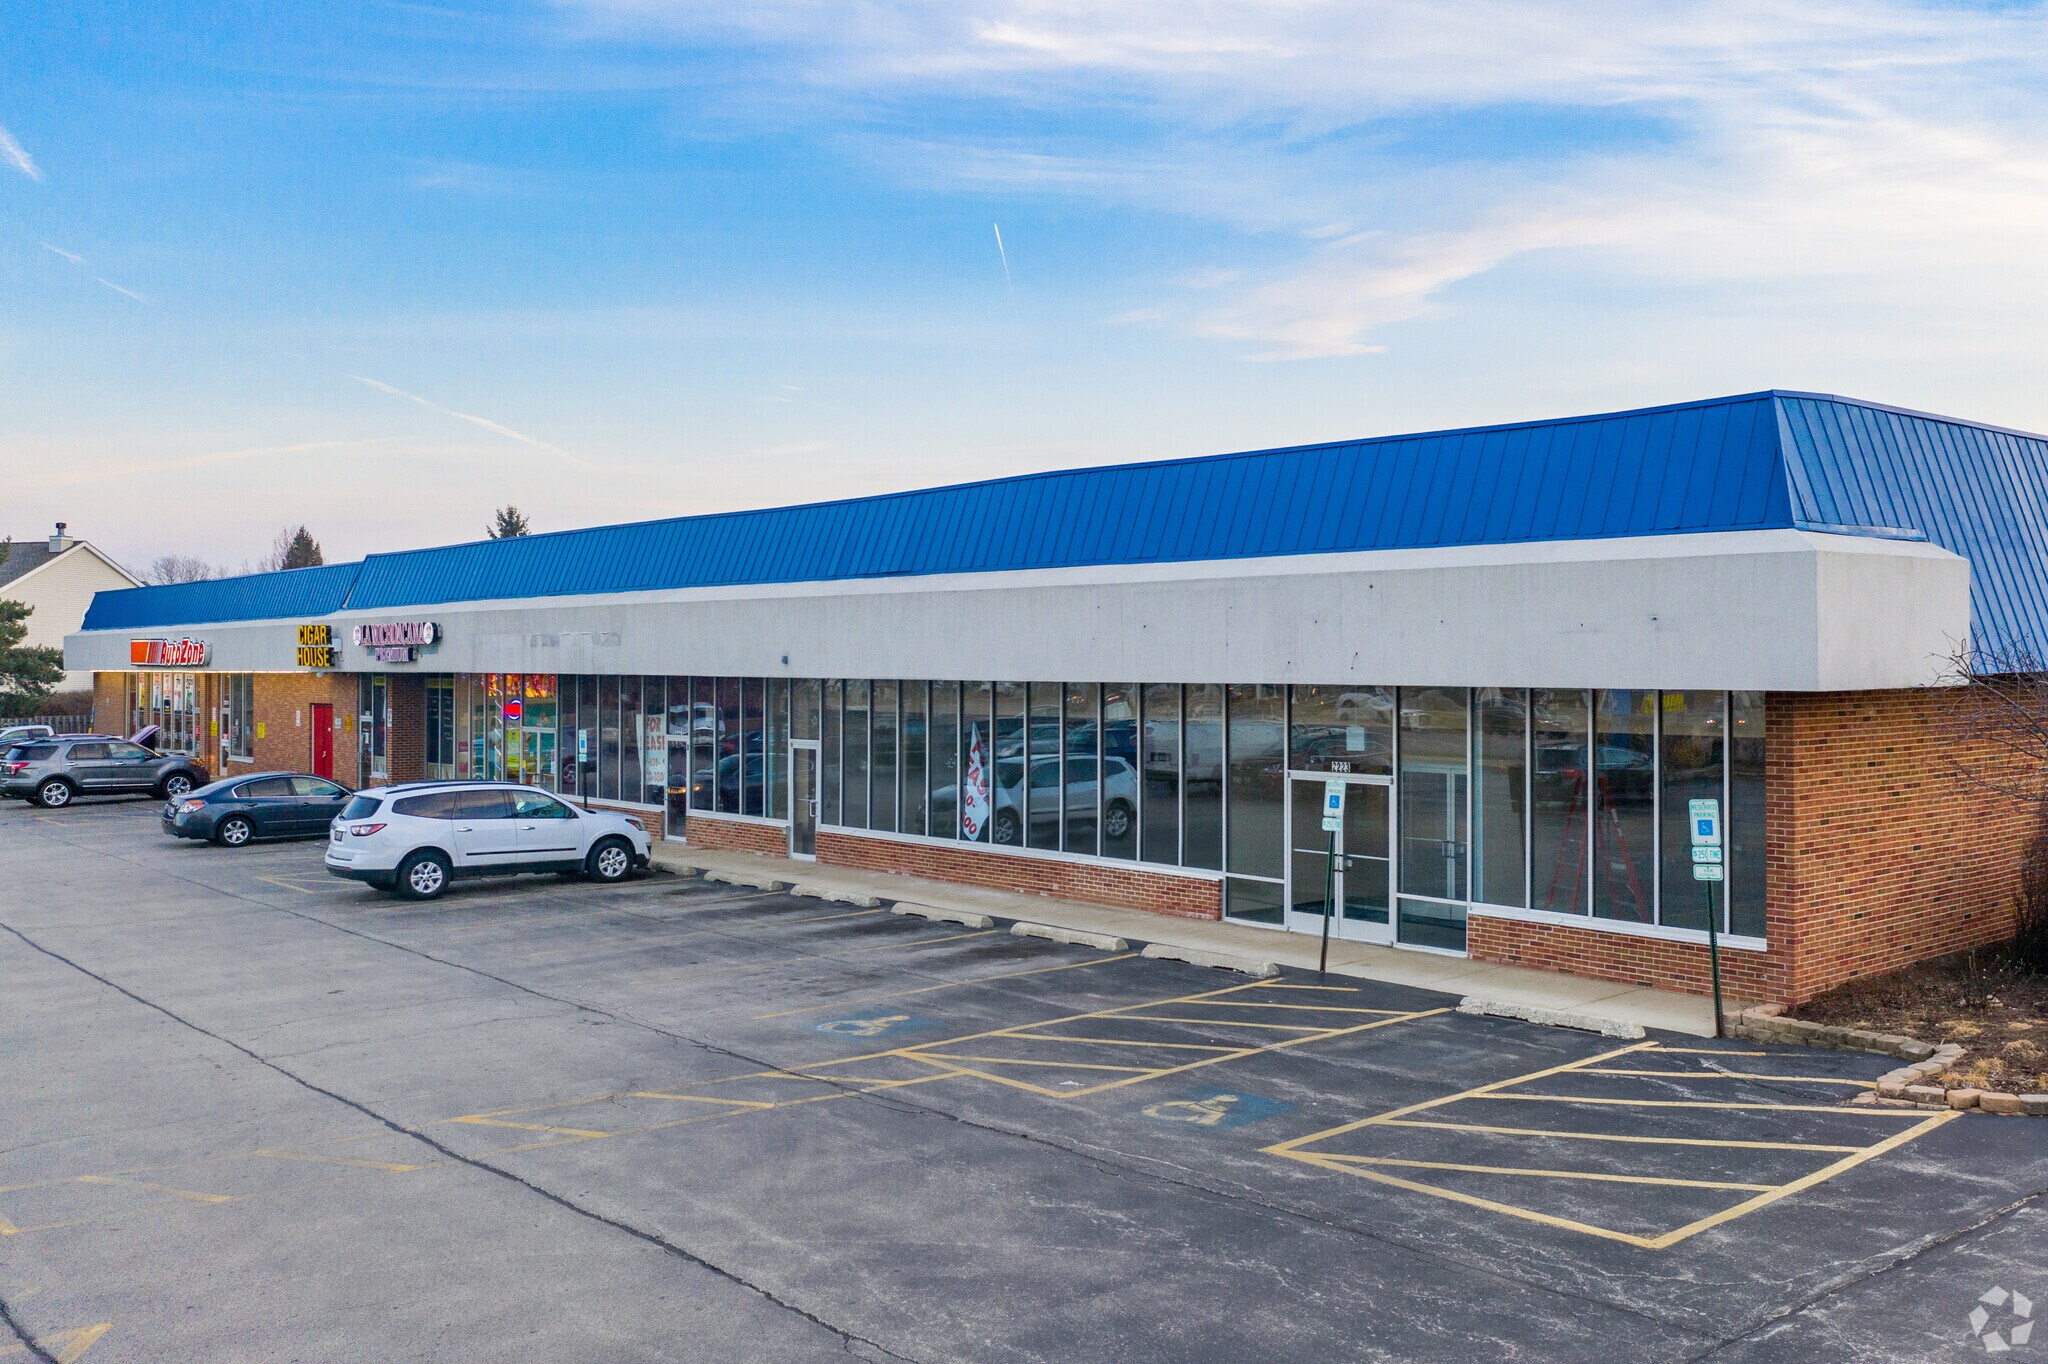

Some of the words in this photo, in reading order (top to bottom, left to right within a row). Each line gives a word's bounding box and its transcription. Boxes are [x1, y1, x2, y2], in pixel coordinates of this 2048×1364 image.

[297, 624, 327, 645] CIGAR
[161, 639, 205, 666] AutoZone
[296, 647, 330, 667] HOUSE
[1332, 762, 1350, 772] 2223
[1693, 850, 1709, 860] $250
[1709, 850, 1721, 860] FINE
